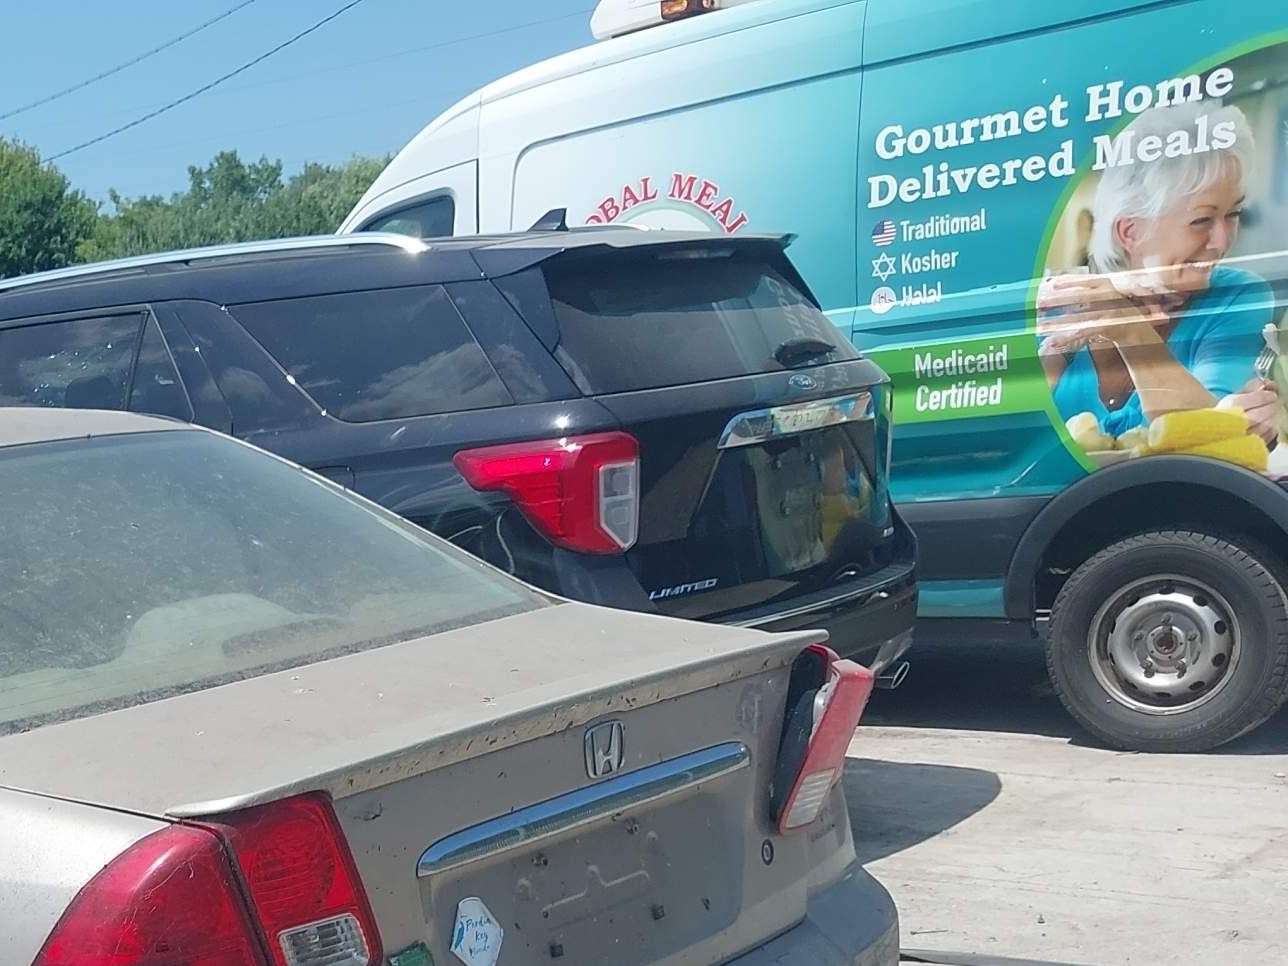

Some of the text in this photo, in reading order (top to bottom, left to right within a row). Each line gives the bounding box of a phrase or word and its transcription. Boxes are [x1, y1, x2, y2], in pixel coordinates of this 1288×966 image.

[875, 67, 1234, 160] Gourmet Home
[867, 115, 1236, 208] Delivered Meals
[900, 208, 987, 242] Traditional
[901, 249, 959, 275] Kosher
[900, 281, 943, 307] Halal
[914, 344, 1008, 379] Medicaid
[915, 377, 1003, 412] Certified
[649, 578, 718, 600] LIMITED
